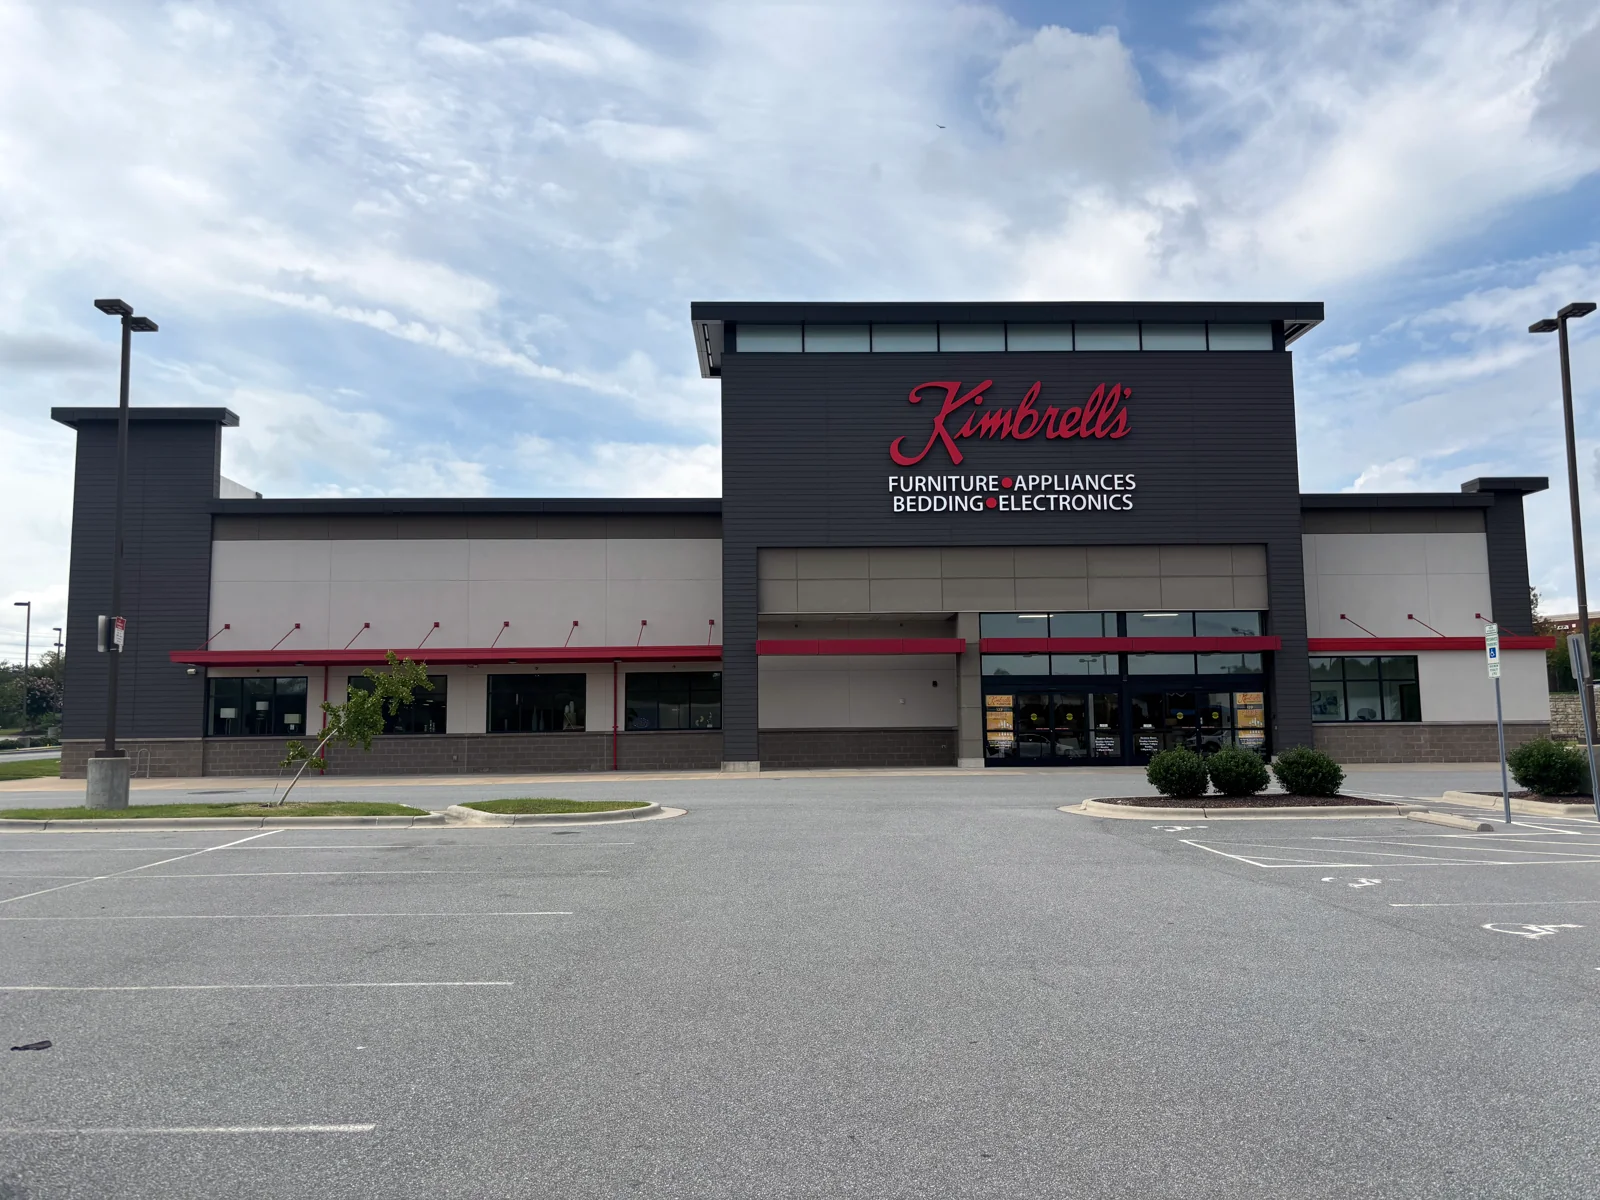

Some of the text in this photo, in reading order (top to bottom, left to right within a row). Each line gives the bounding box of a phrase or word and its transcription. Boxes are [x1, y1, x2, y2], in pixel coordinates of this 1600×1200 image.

[889, 379, 1132, 466] Kimbrell's
[888, 474, 1136, 492] FURNITURE APPLIANCES
[893, 493, 1134, 512] BEDDING ELECTRONICS
